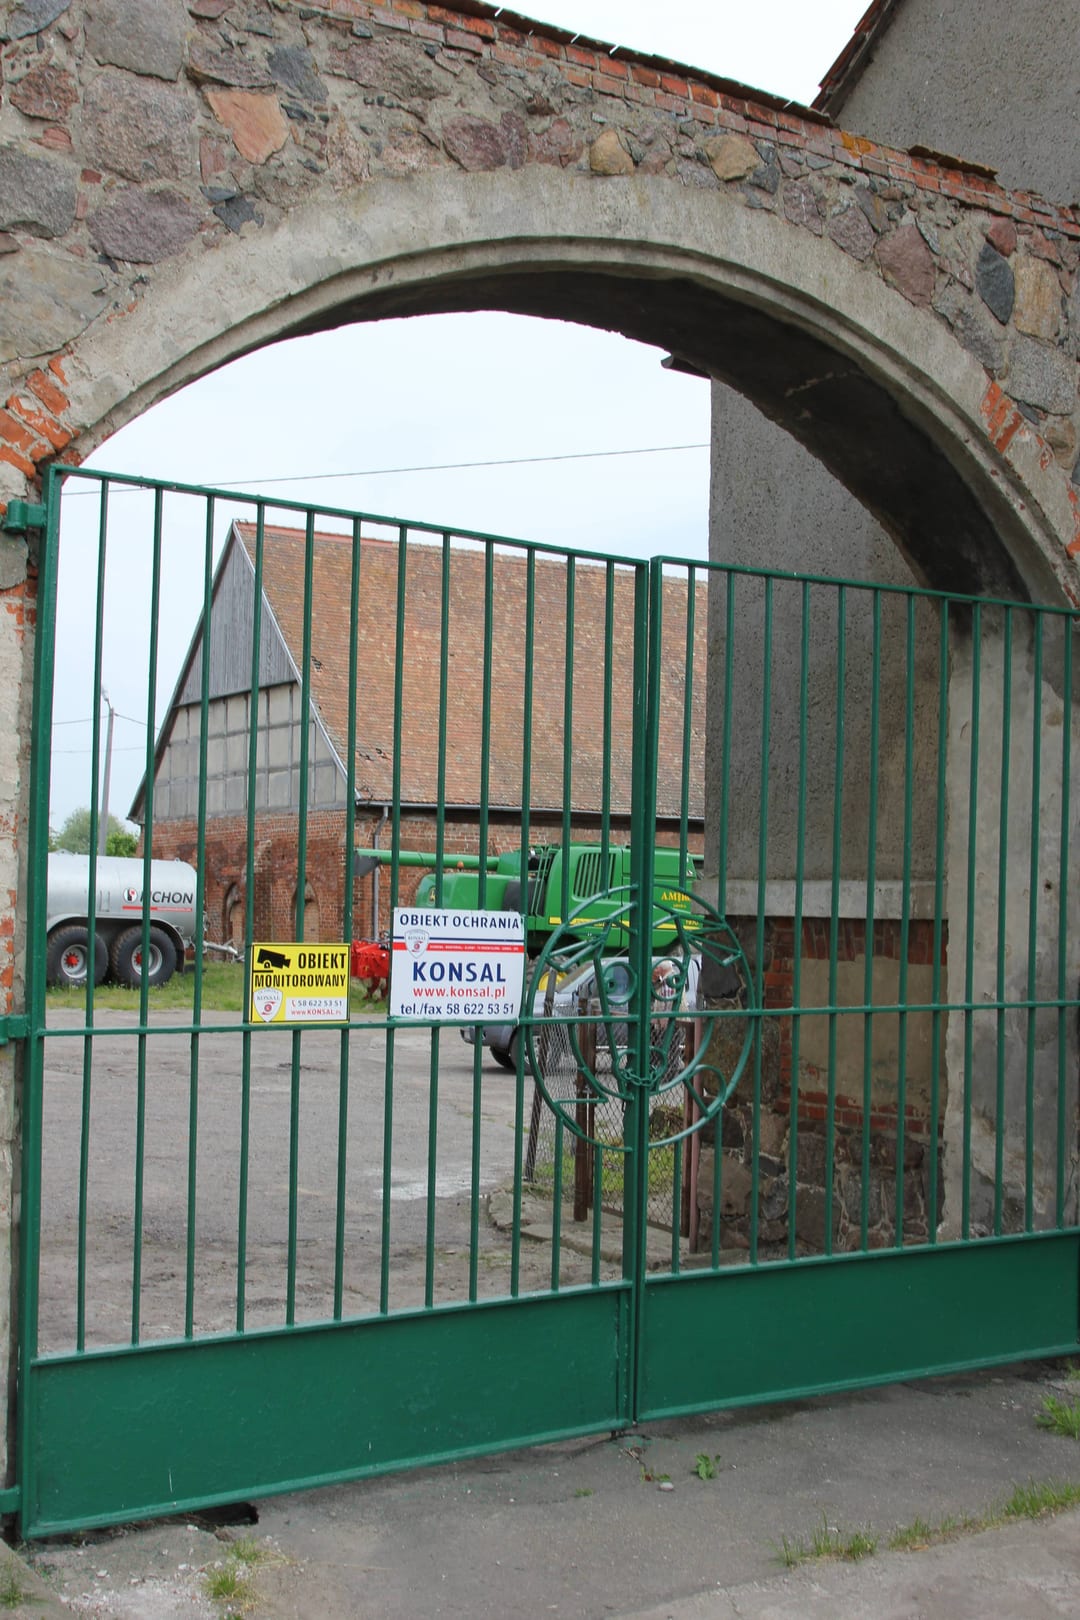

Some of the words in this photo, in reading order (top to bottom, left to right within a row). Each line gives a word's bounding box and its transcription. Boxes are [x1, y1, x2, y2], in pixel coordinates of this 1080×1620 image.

[141, 890, 193, 904] CHON
[400, 914, 448, 926] OBIEKT
[452, 915, 523, 929] OCHRANIA
[298, 952, 347, 969] OBIEKT
[413, 961, 506, 982] KONSAL
[254, 974, 346, 988] MONITOROWANY
[413, 985, 506, 999] www.konsal.pl
[297, 999, 307, 1007] 58
[308, 999, 322, 1007] 622
[323, 999, 333, 1007] 53
[334, 999, 342, 1007] 51
[400, 1002, 442, 1015] tel./fax
[446, 1003, 460, 1015] 58
[463, 1003, 484, 1015] 622
[487, 1003, 500, 1015] 53
[503, 1003, 514, 1015] 51
